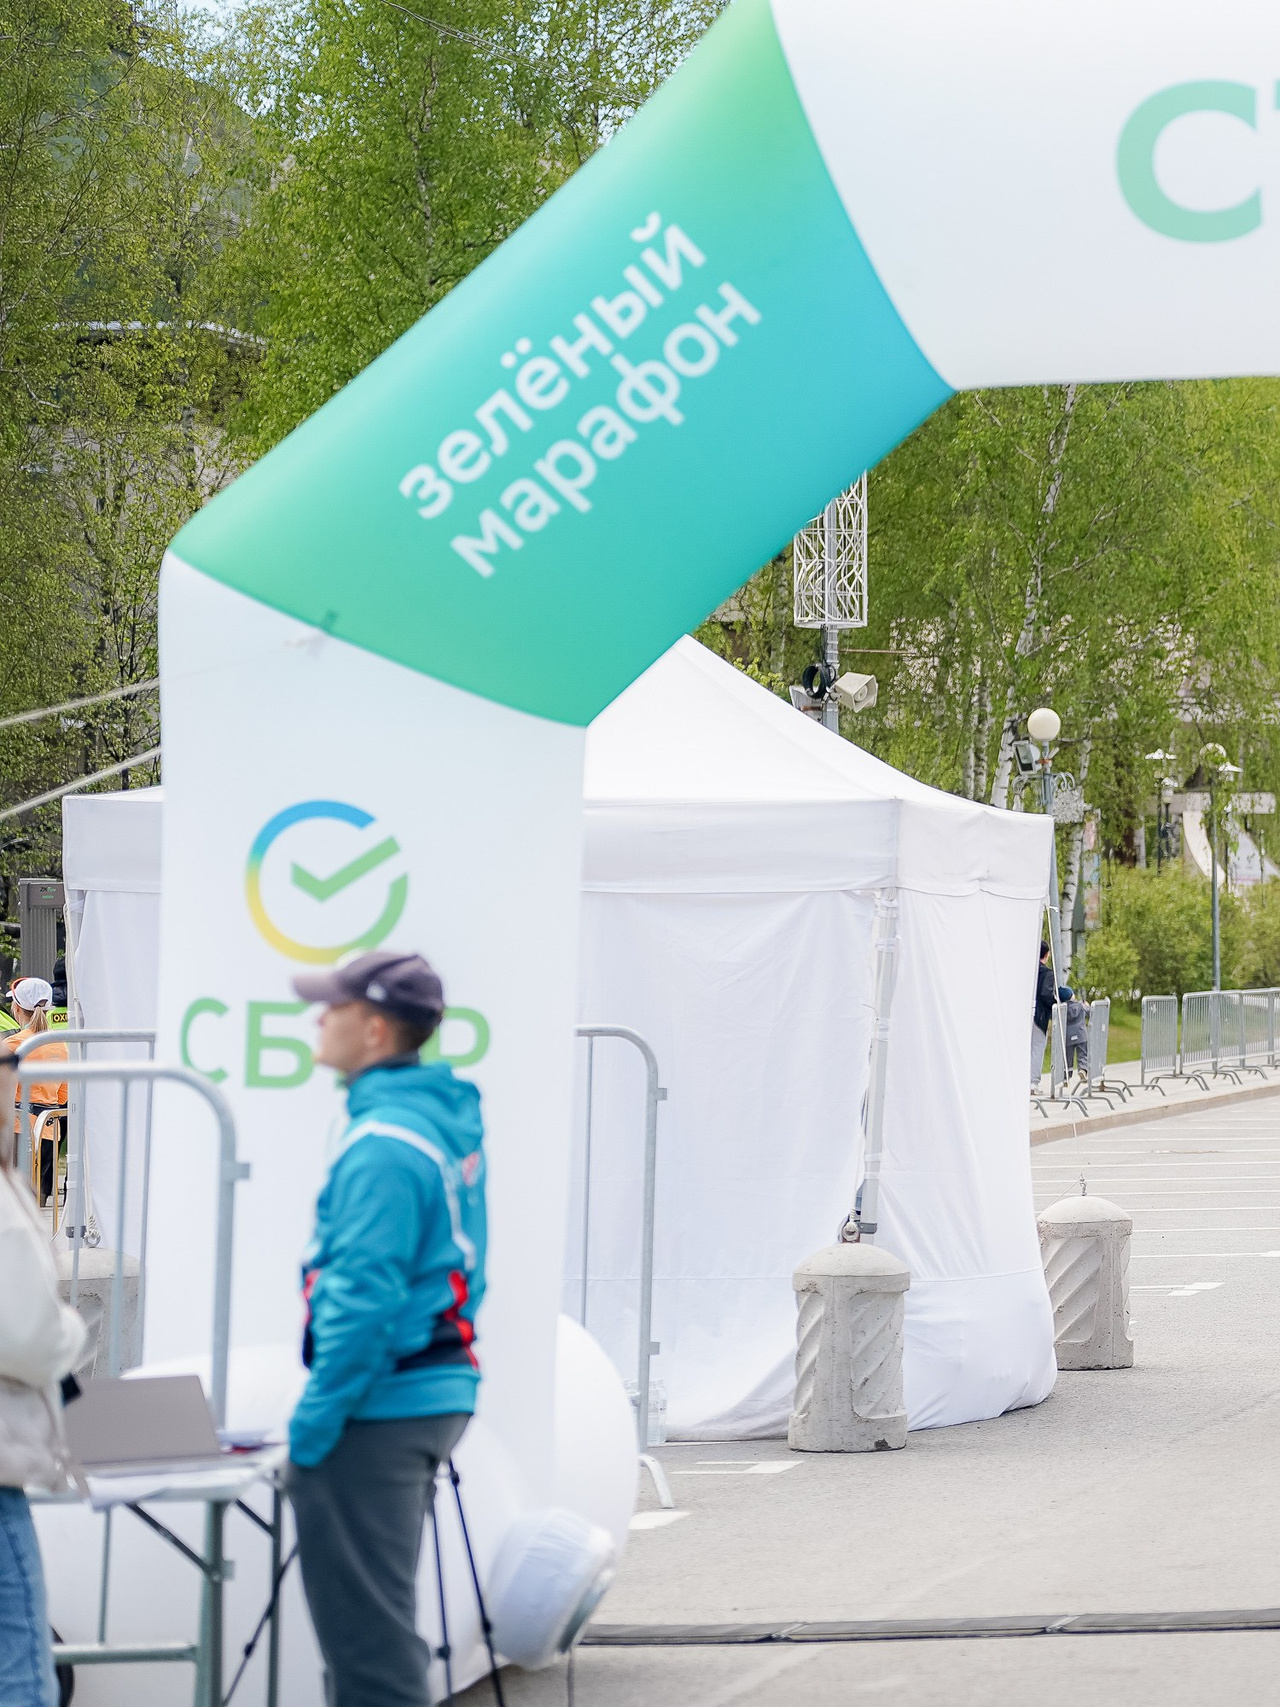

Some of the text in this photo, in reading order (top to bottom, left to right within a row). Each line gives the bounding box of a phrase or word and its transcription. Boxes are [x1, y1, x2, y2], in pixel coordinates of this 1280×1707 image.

[398, 211, 706, 520] зелёный
[450, 281, 762, 578] марафон
[180, 997, 490, 1089] СБР
